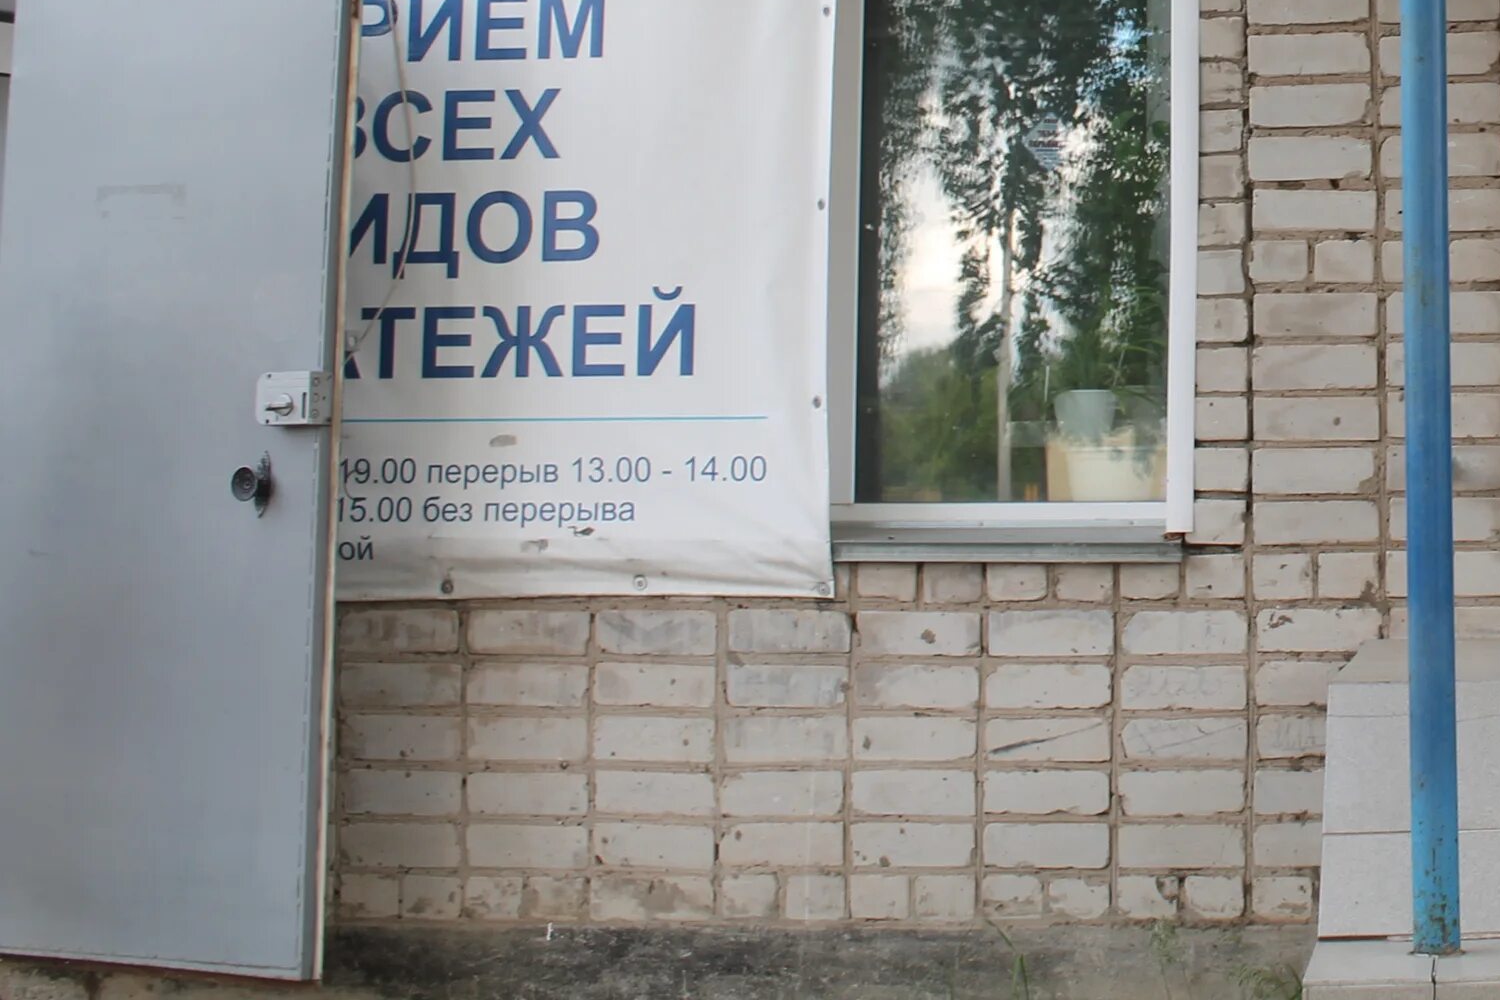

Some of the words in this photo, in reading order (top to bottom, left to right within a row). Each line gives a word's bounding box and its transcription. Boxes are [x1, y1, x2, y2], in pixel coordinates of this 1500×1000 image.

[427, 463, 559, 491] перерыв
[572, 456, 652, 483] 13.00
[685, 455, 768, 482] 14.00
[423, 496, 474, 523] без
[484, 500, 636, 528] перерыва
